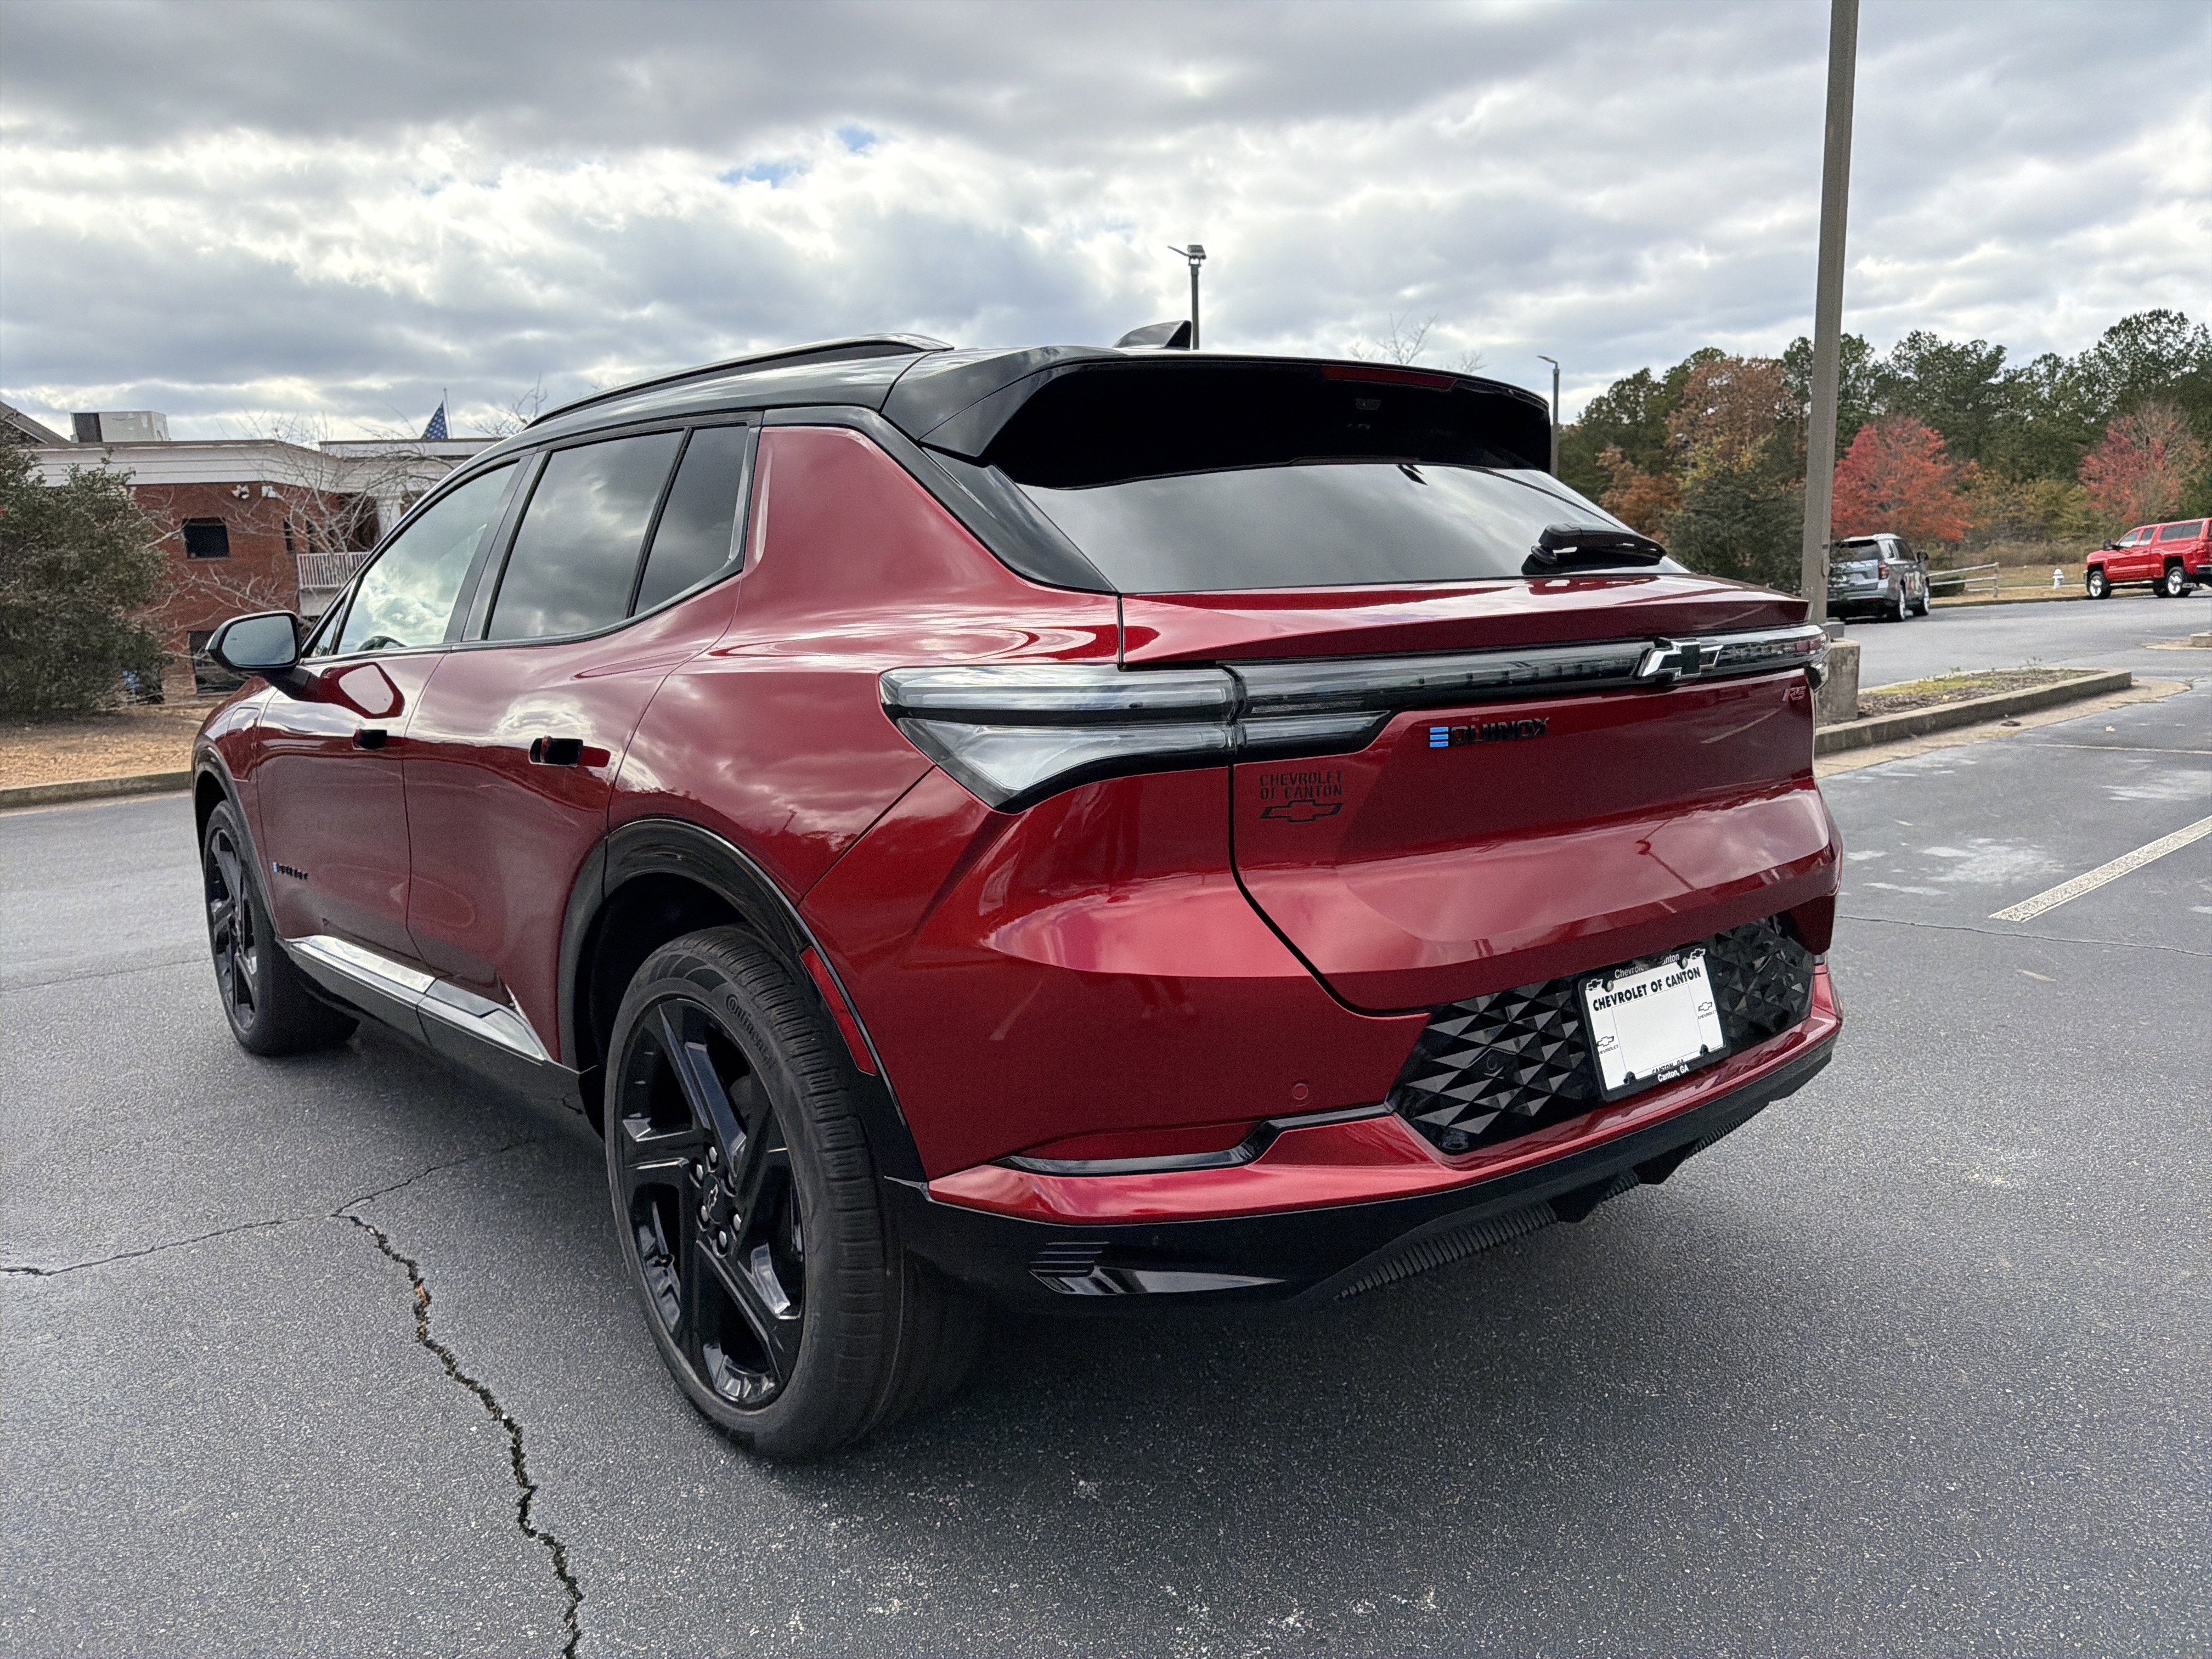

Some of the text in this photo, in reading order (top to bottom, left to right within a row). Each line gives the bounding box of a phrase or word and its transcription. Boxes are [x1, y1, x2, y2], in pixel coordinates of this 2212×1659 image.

[1782, 686, 1807, 702] RS
[1429, 717, 1550, 748] EQUINOX
[1260, 770, 1342, 786] CHEVROLET
[1260, 783, 1342, 800] OF CANTON
[1614, 966, 1645, 979] Chevrol
[1593, 966, 1701, 1012] CHEVROLET OF CANTON
[1657, 1064, 1689, 1082] Canton, GA
